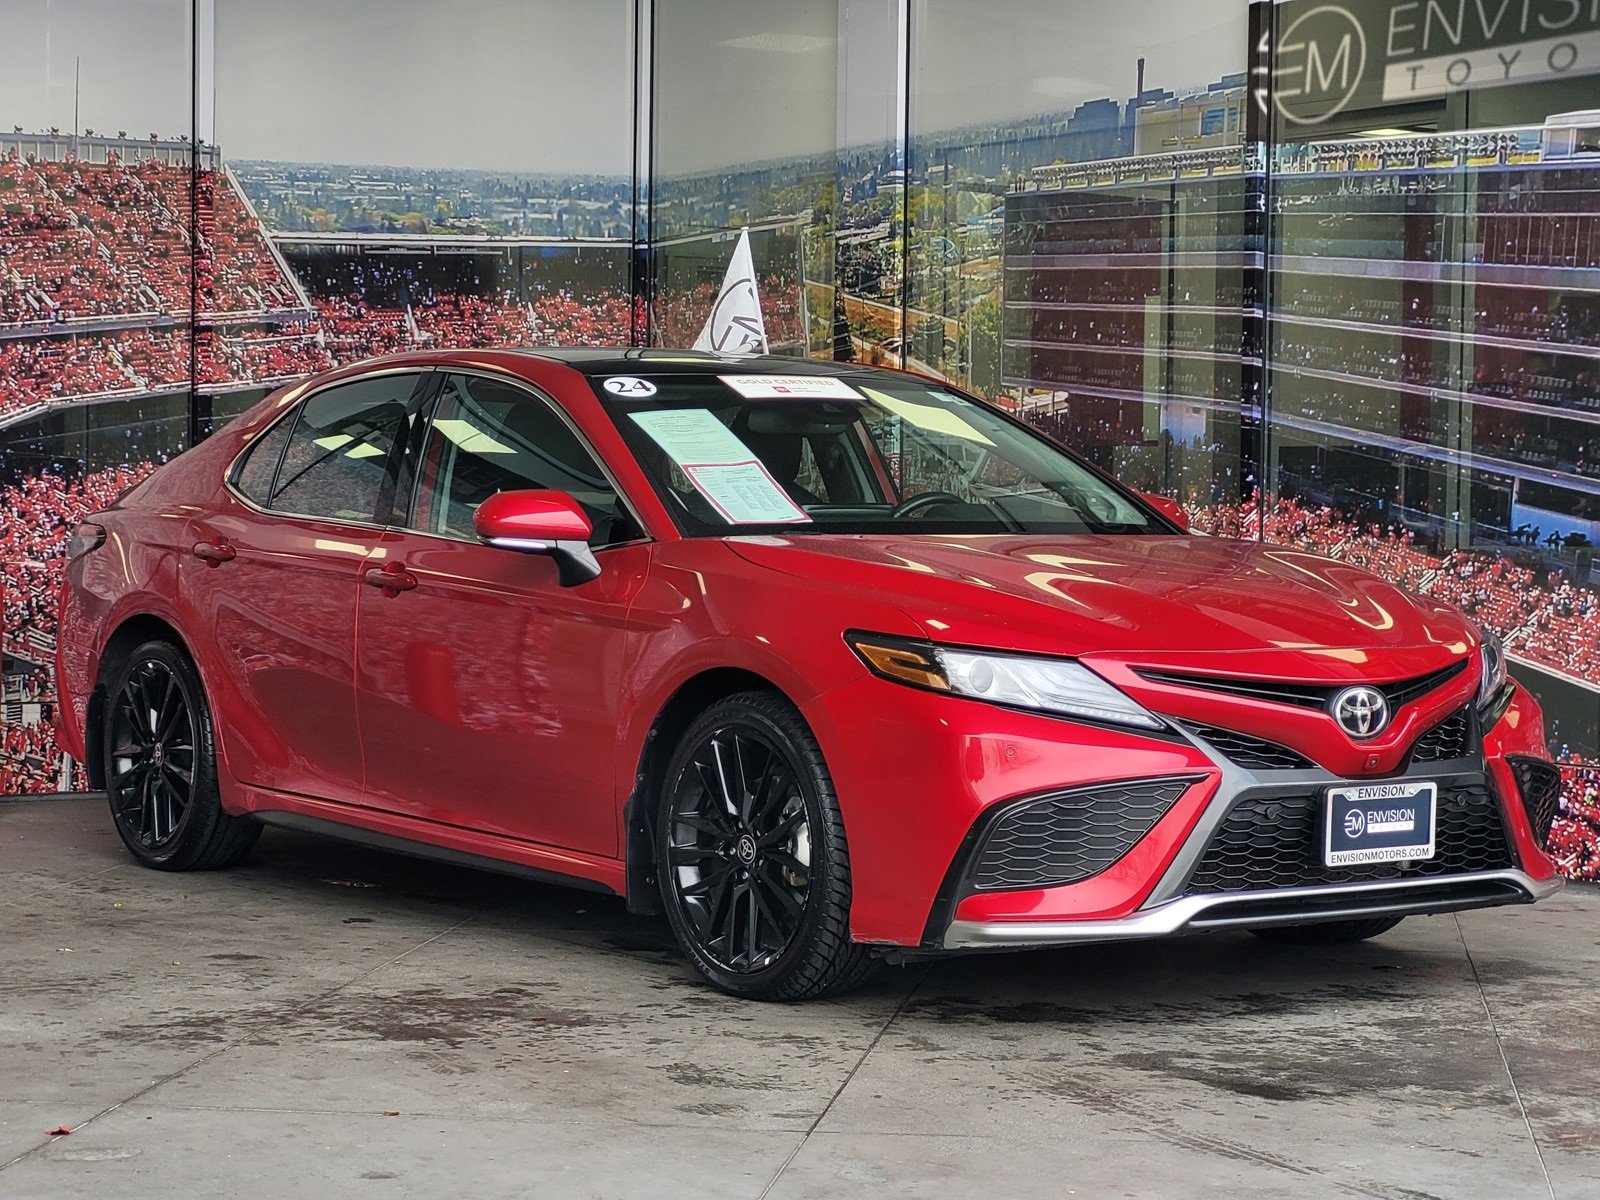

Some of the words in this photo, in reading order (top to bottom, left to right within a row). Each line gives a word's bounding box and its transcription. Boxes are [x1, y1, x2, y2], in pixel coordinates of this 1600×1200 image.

[609, 380, 652, 393] 24
[1358, 786, 1406, 799] ENVISION
[1367, 808, 1415, 823] ENVISION
[1331, 847, 1429, 864] ENVISIONMOTORS.COM
